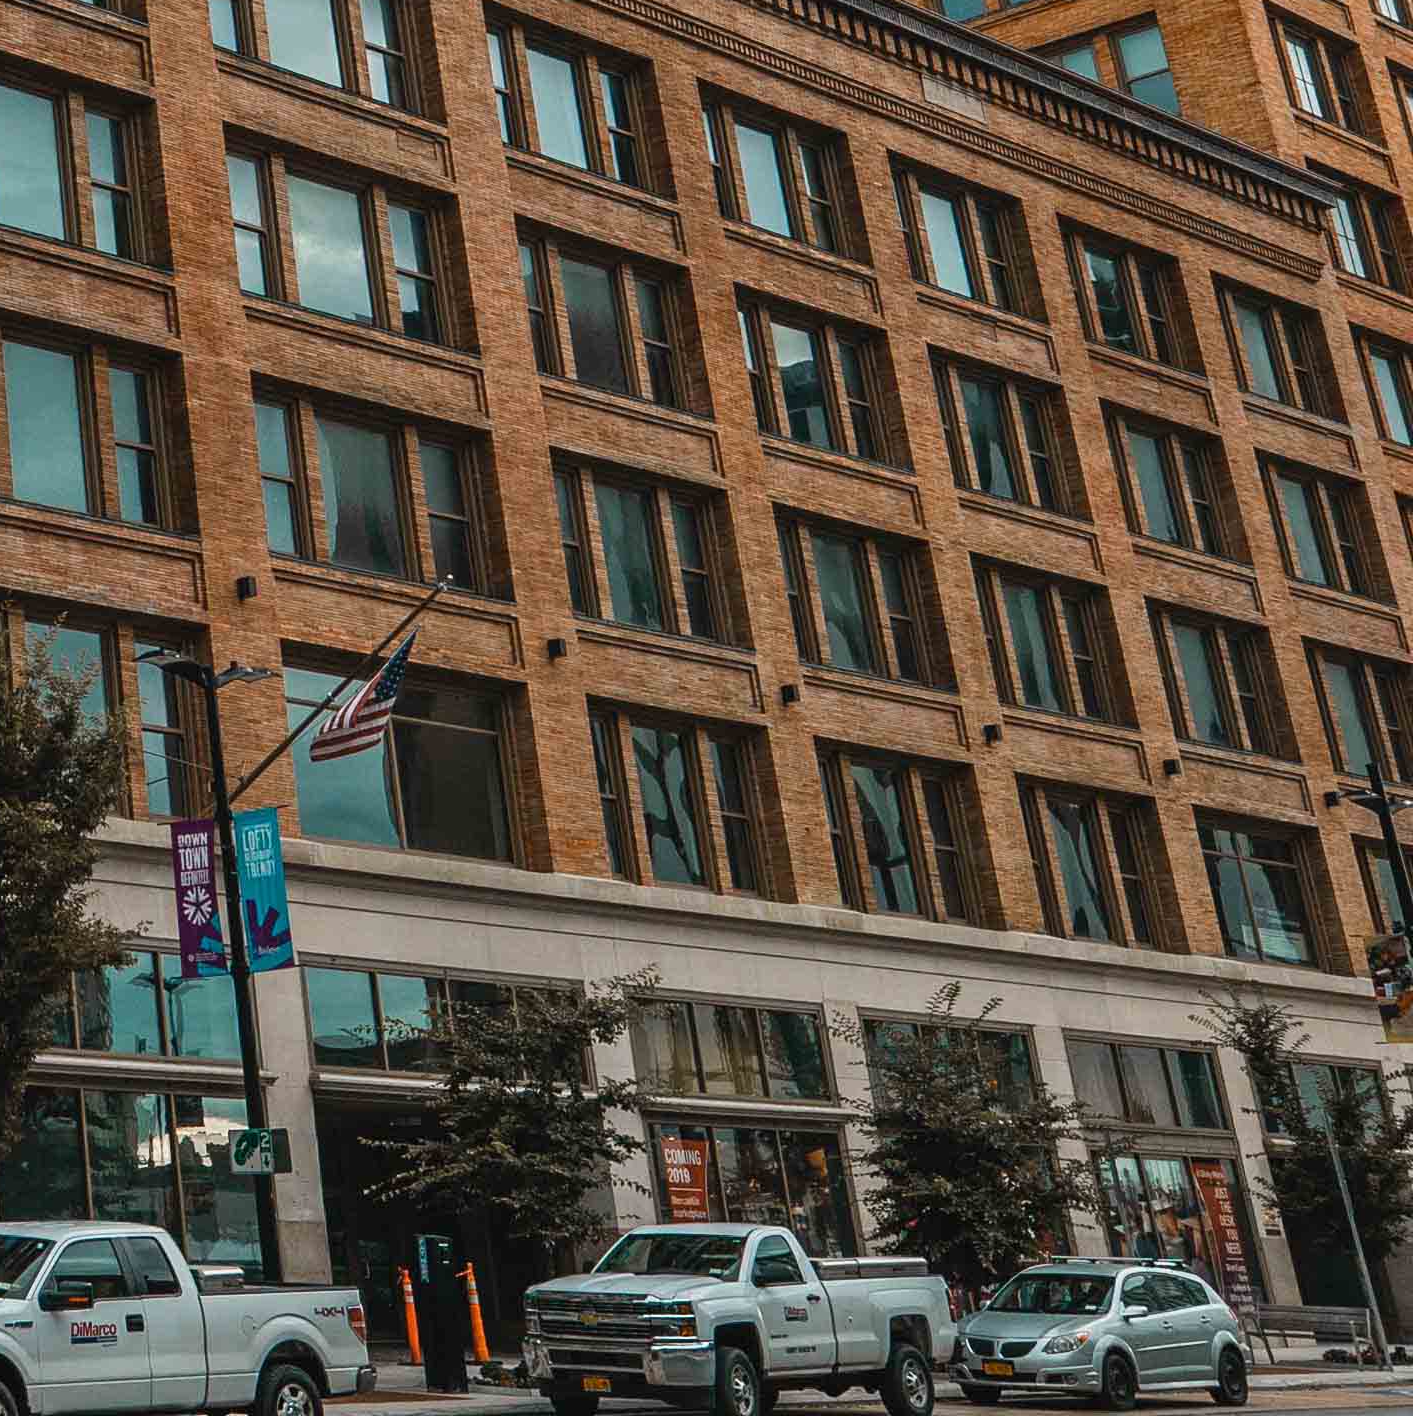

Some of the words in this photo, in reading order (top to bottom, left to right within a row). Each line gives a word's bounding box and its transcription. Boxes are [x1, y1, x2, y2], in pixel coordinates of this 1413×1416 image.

[177, 832, 208, 846] DOWN
[178, 846, 209, 871] TOWN
[664, 1148, 702, 1166] COMING
[667, 1167, 691, 1184] 2019
[71, 1322, 117, 1336] DiMarco
